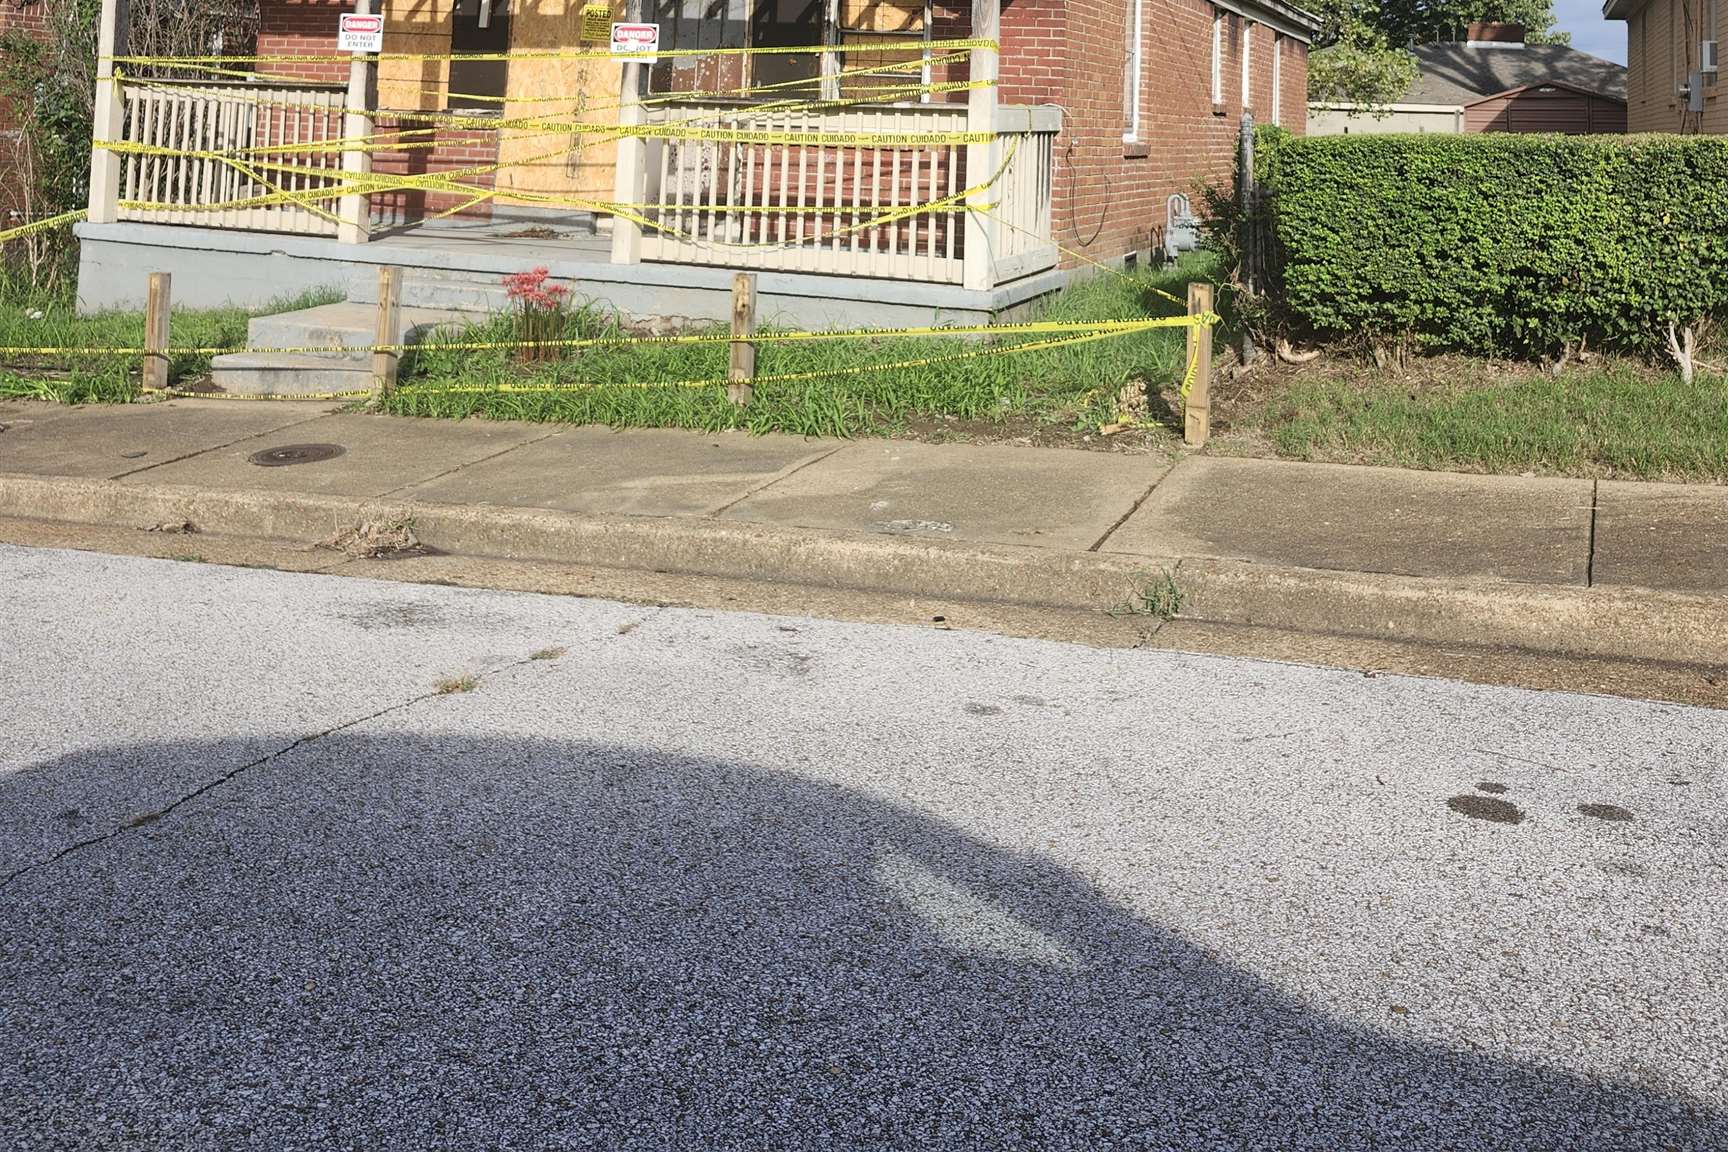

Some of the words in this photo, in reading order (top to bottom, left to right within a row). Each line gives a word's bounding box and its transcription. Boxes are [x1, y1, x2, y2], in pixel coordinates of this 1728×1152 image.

[586, 8, 612, 19] POSTED
[345, 20, 378, 29] DANGER
[616, 29, 653, 39] DANGER
[541, 122, 572, 132] CAUTION
[654, 126, 686, 137] CUIDADO
[700, 131, 733, 140] CAUTION
[736, 132, 769, 141] CUIDADO
[785, 133, 819, 142] CAUTION
[821, 134, 855, 143] CUIDADO
[871, 134, 907, 144] CAUTION
[910, 134, 946, 143] CUIDADO
[448, 167, 477, 180] CUIDADO
[307, 188, 335, 199] CUIDADO
[346, 183, 375, 194] CAUTION
[15, 221, 50, 237] CAUTION
[52, 210, 87, 227] CUIDADO
